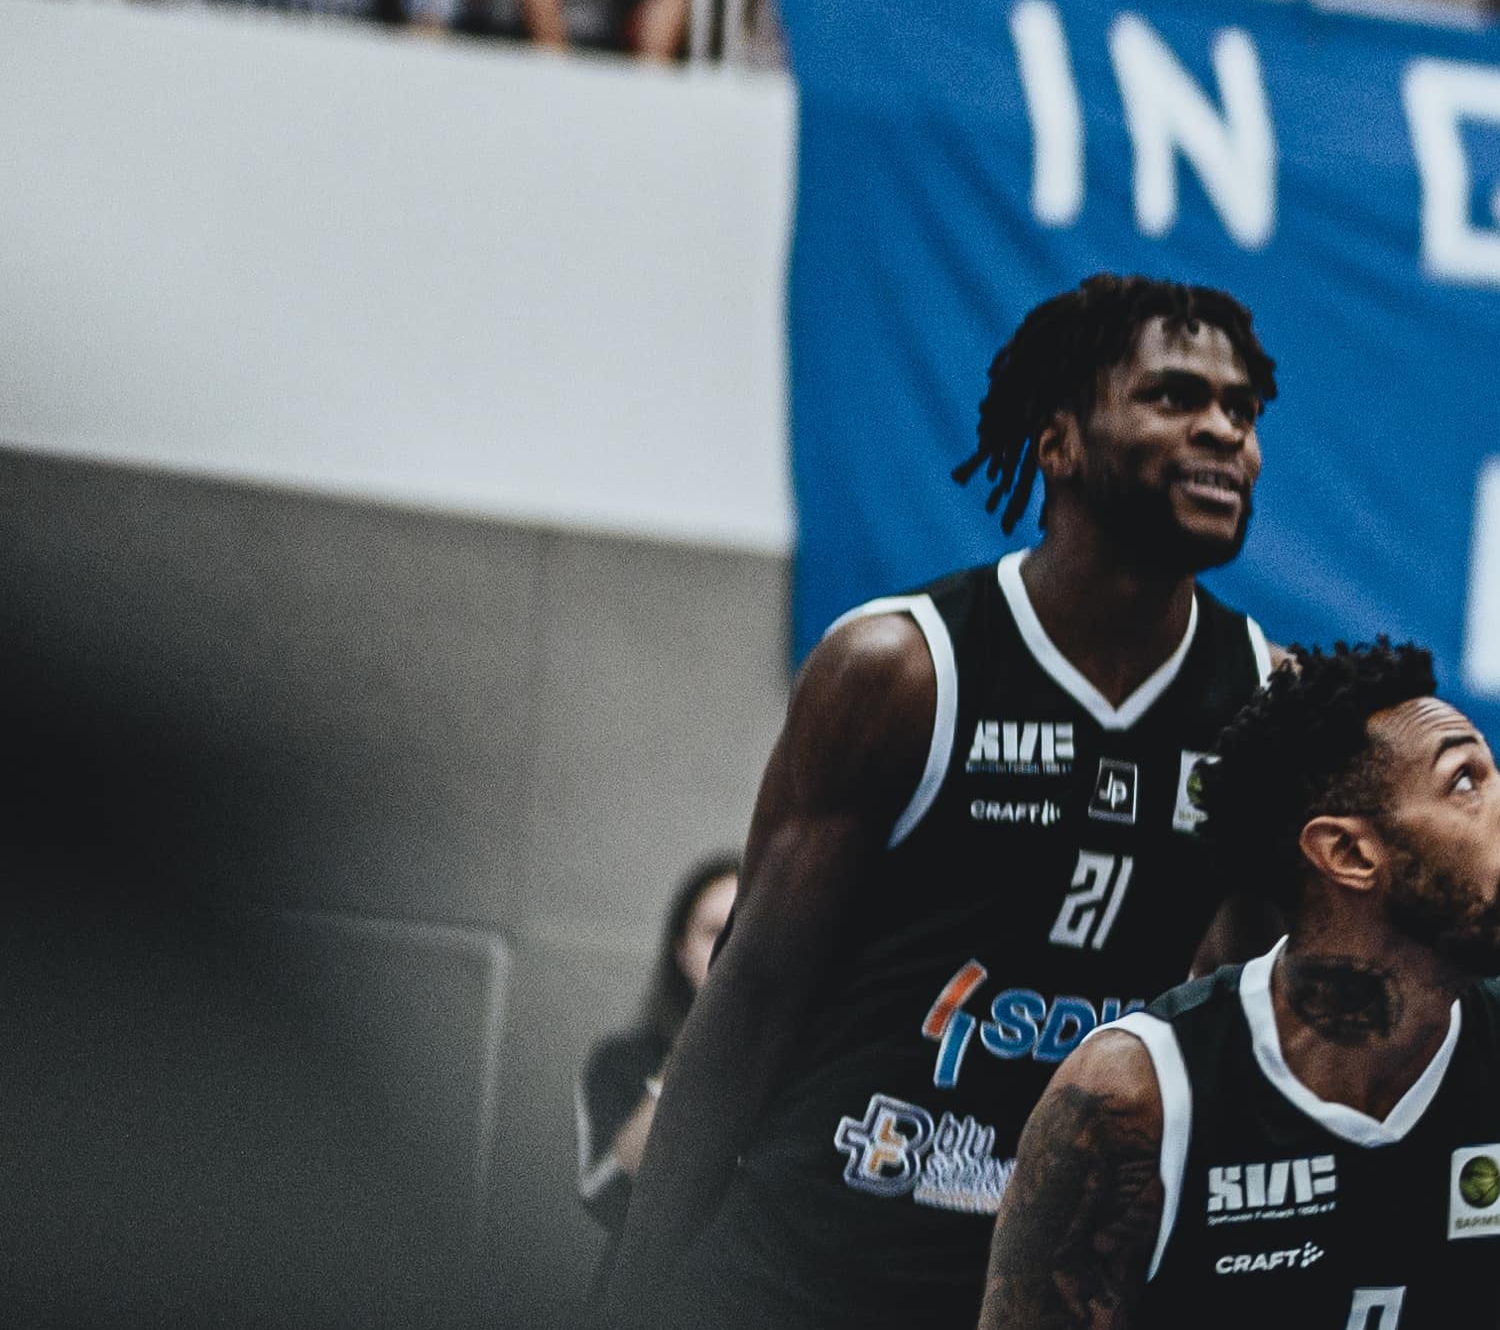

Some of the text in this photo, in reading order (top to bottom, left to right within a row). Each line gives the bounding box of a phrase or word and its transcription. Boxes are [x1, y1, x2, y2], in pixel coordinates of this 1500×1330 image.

[970, 800, 1041, 824] CRAFT
[1049, 849, 1135, 950] 21
[1215, 1248, 1302, 1274] CRAFT
